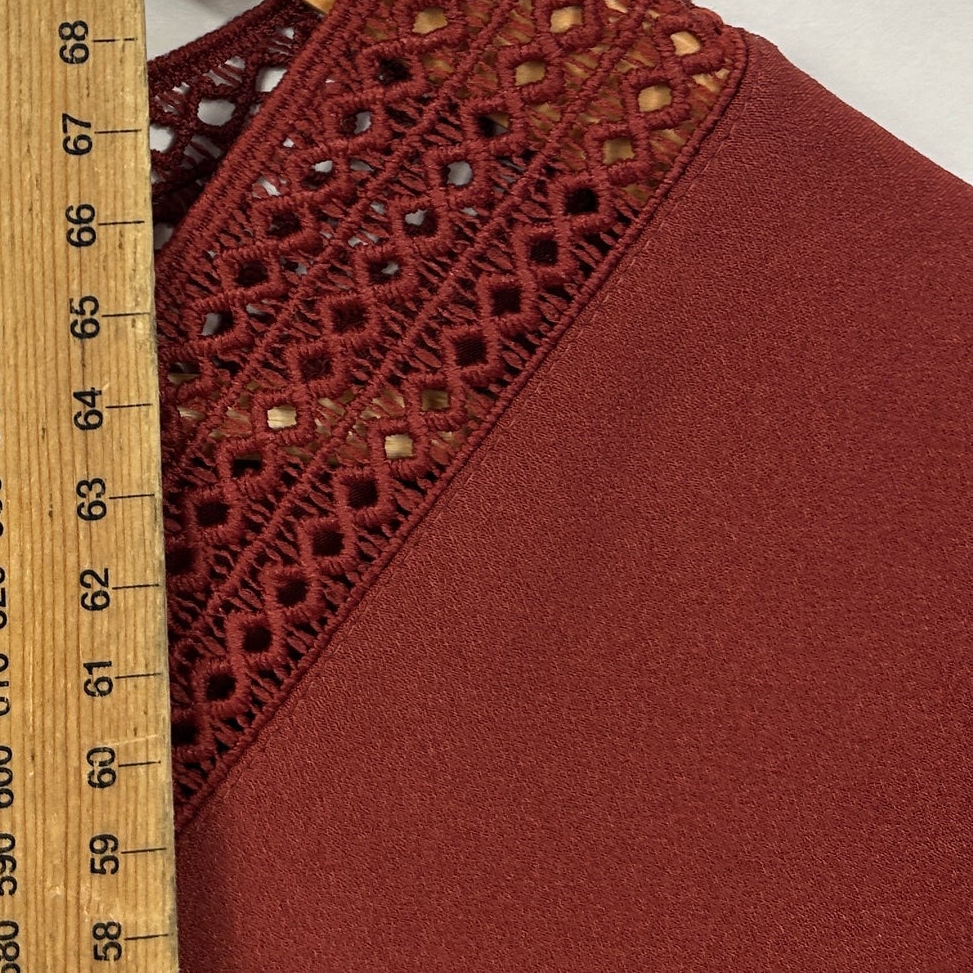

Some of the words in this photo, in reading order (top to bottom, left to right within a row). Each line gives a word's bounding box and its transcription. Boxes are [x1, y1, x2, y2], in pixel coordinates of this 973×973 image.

[58, 20, 90, 65] 68
[61, 112, 93, 157] 67
[64, 203, 97, 249] 66
[68, 295, 101, 341] 65
[72, 386, 104, 432] 64
[75, 477, 107, 522] 63
[78, 567, 111, 612] 62
[82, 660, 114, 698] 61
[86, 746, 117, 790] 60
[88, 833, 120, 876] 59
[91, 921, 123, 962] 58
